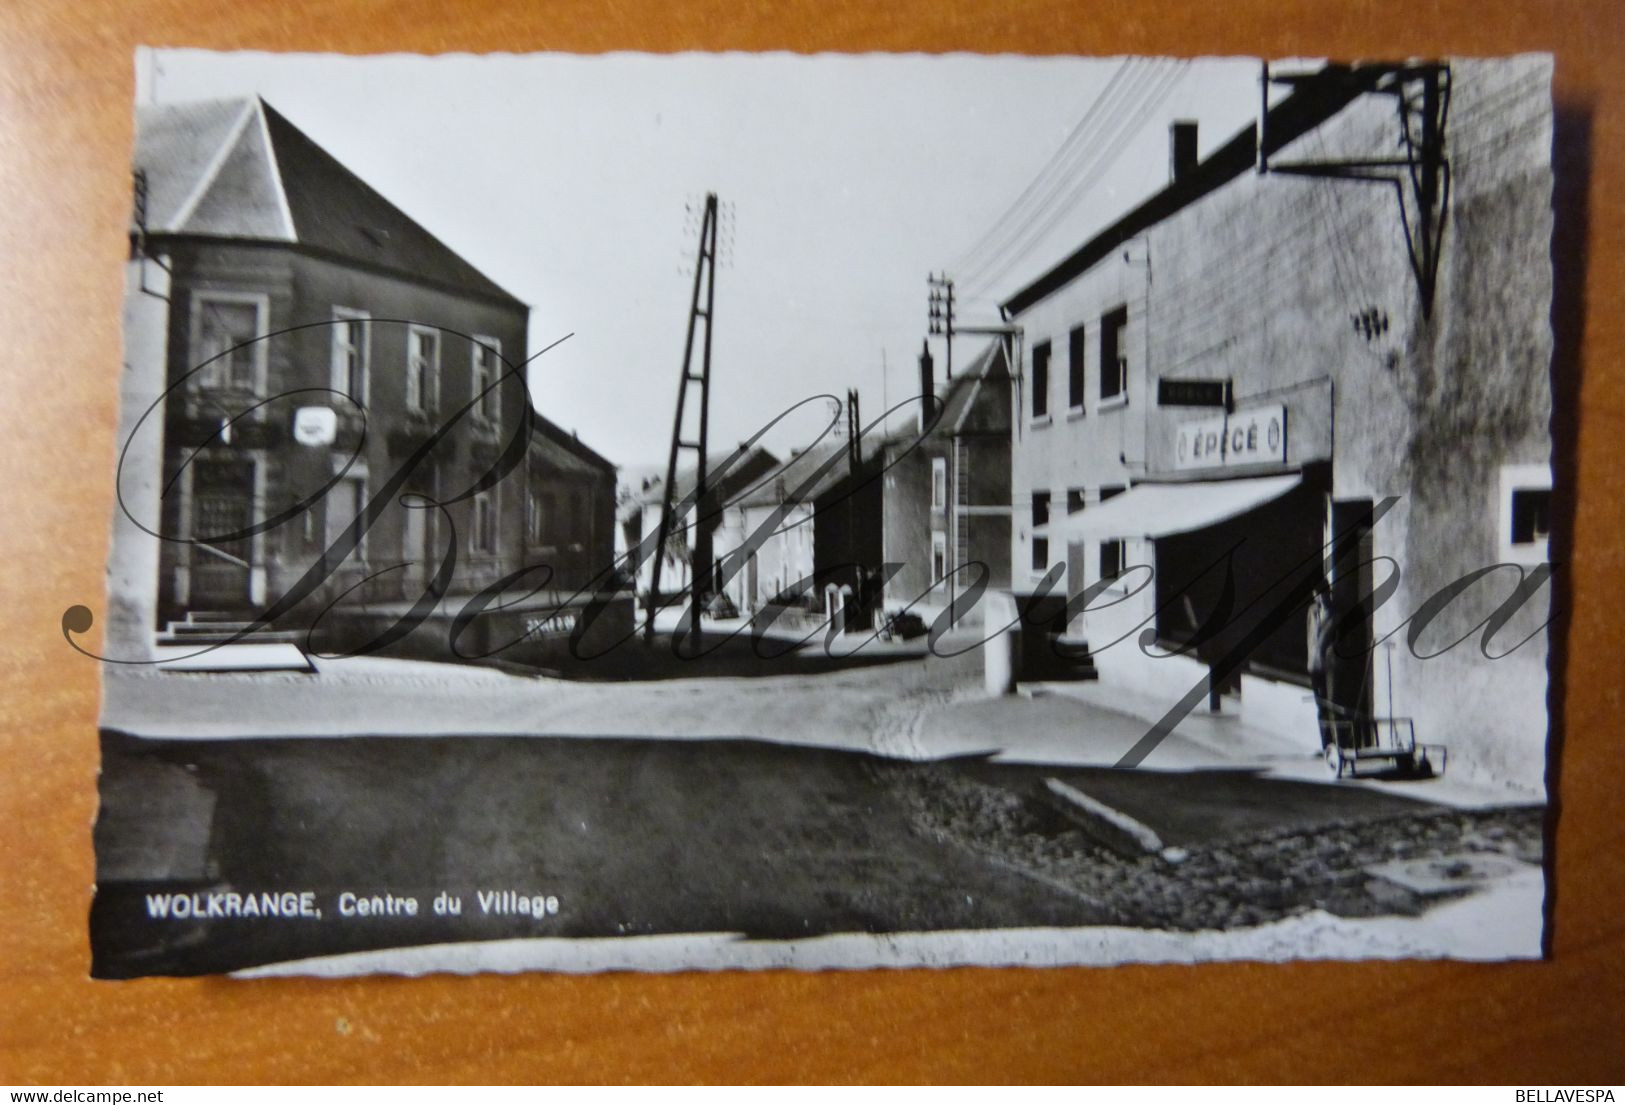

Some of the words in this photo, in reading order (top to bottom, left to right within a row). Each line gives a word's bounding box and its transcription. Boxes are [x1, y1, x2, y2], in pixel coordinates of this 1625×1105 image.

[146, 892, 322, 920] WOLKRANGE,
[338, 892, 419, 917] Centre
[432, 891, 462, 915] du
[476, 890, 560, 919] Village
